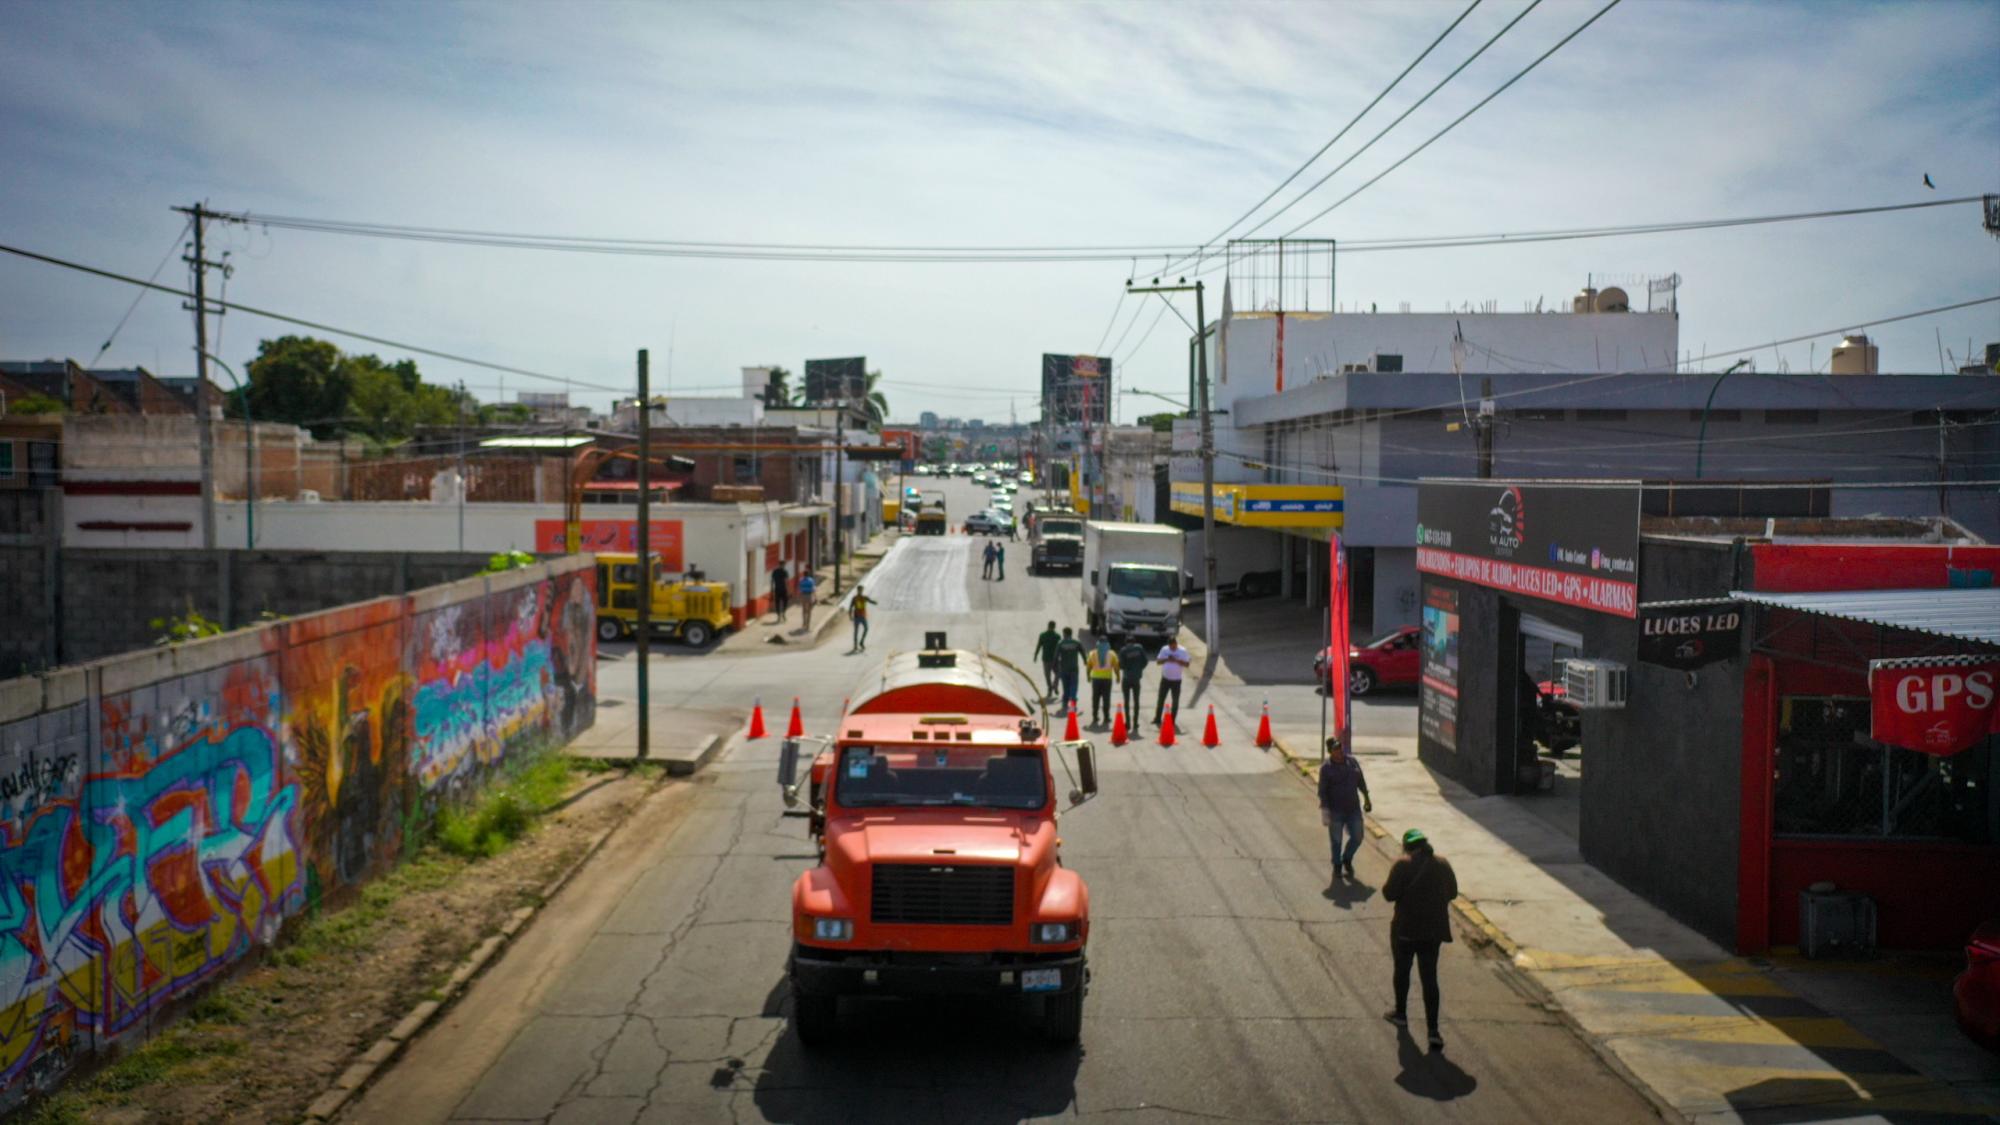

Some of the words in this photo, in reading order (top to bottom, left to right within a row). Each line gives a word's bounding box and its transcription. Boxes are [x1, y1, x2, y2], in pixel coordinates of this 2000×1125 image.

[1499, 536, 1519, 549] AUTO
[1455, 555, 1480, 579] EQUIPOS
[1481, 560, 1490, 582] DE
[1492, 562, 1512, 586] AUDIO
[1517, 567, 1540, 593] LUCES
[1542, 571, 1557, 596] LED
[1563, 575, 1582, 601] GPS
[1589, 579, 1633, 612] ALARMAS
[1643, 615, 1701, 636] LUCES
[1705, 611, 1740, 632] LED
[1895, 670, 1995, 714] GPS
